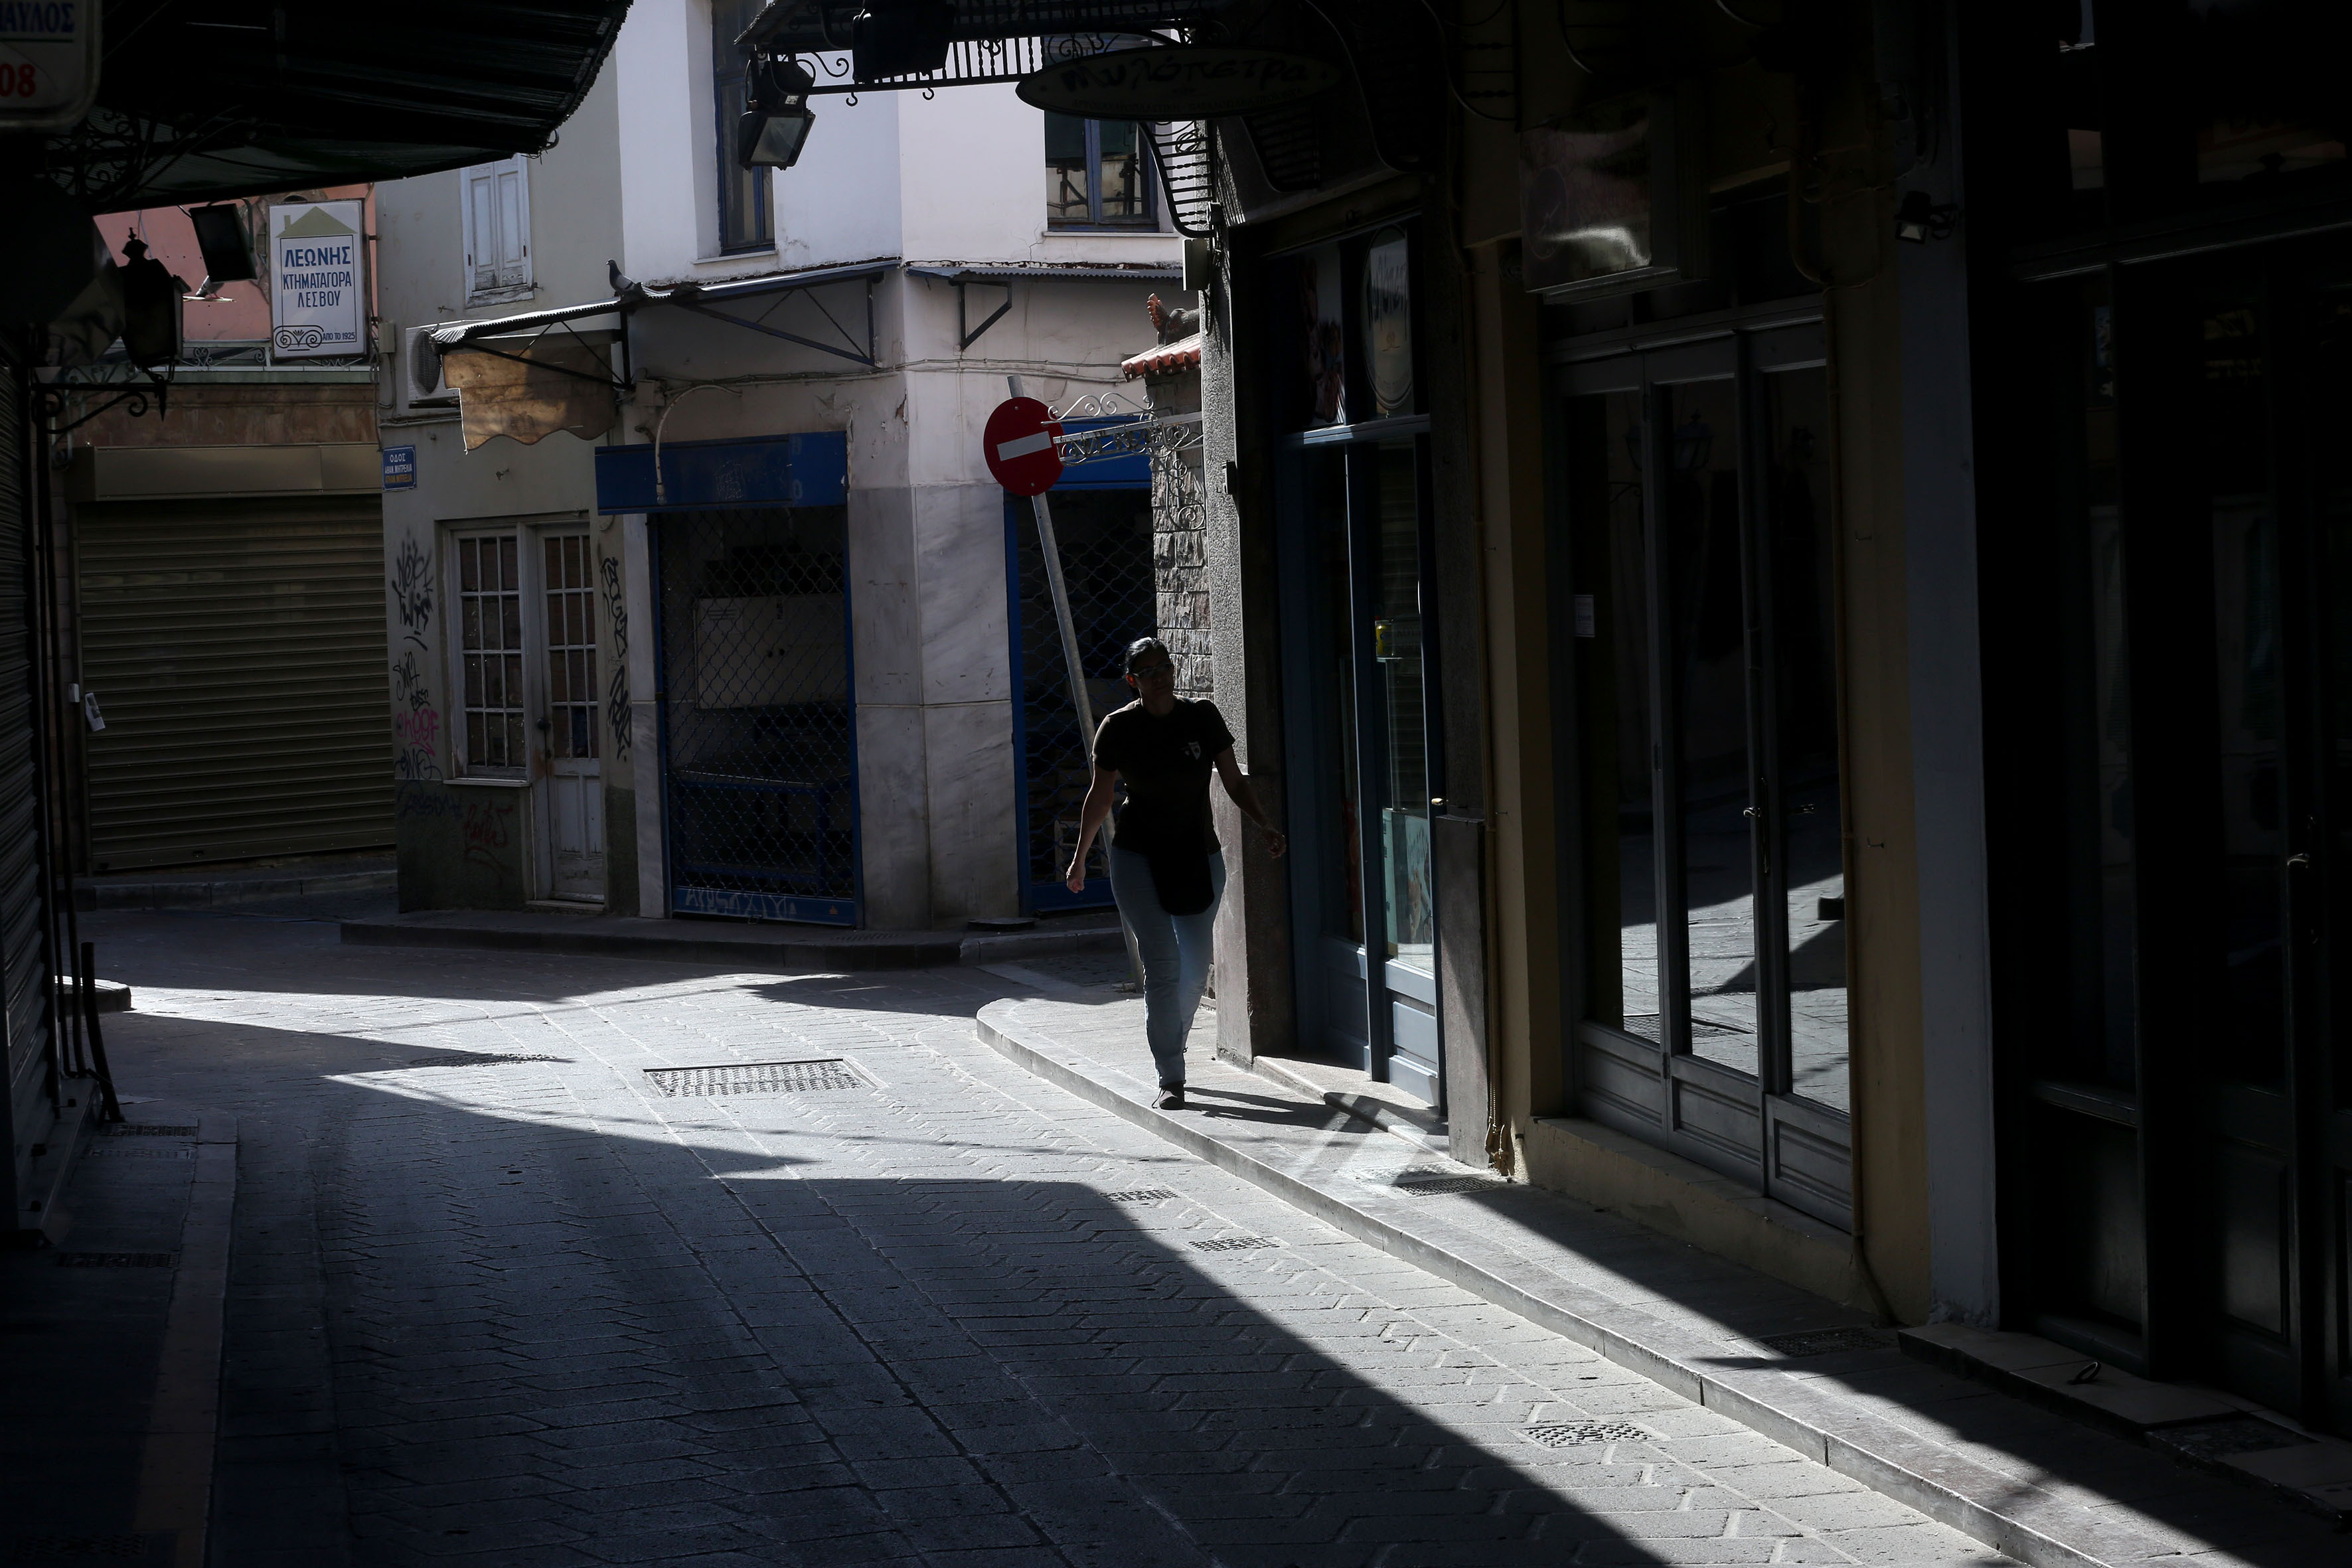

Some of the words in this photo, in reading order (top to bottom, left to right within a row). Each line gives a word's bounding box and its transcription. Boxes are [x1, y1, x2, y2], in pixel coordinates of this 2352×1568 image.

[284, 246, 351, 268] ΛΕΩΝΗΣ
[283, 271, 352, 290] ΚΤΗΜΑΤΑΓΟΡΑ
[297, 290, 341, 308] ΛΕΣΒΟΥ
[342, 332, 356, 341] 1925
[389, 453, 406, 462] ΟΔΟΣ
